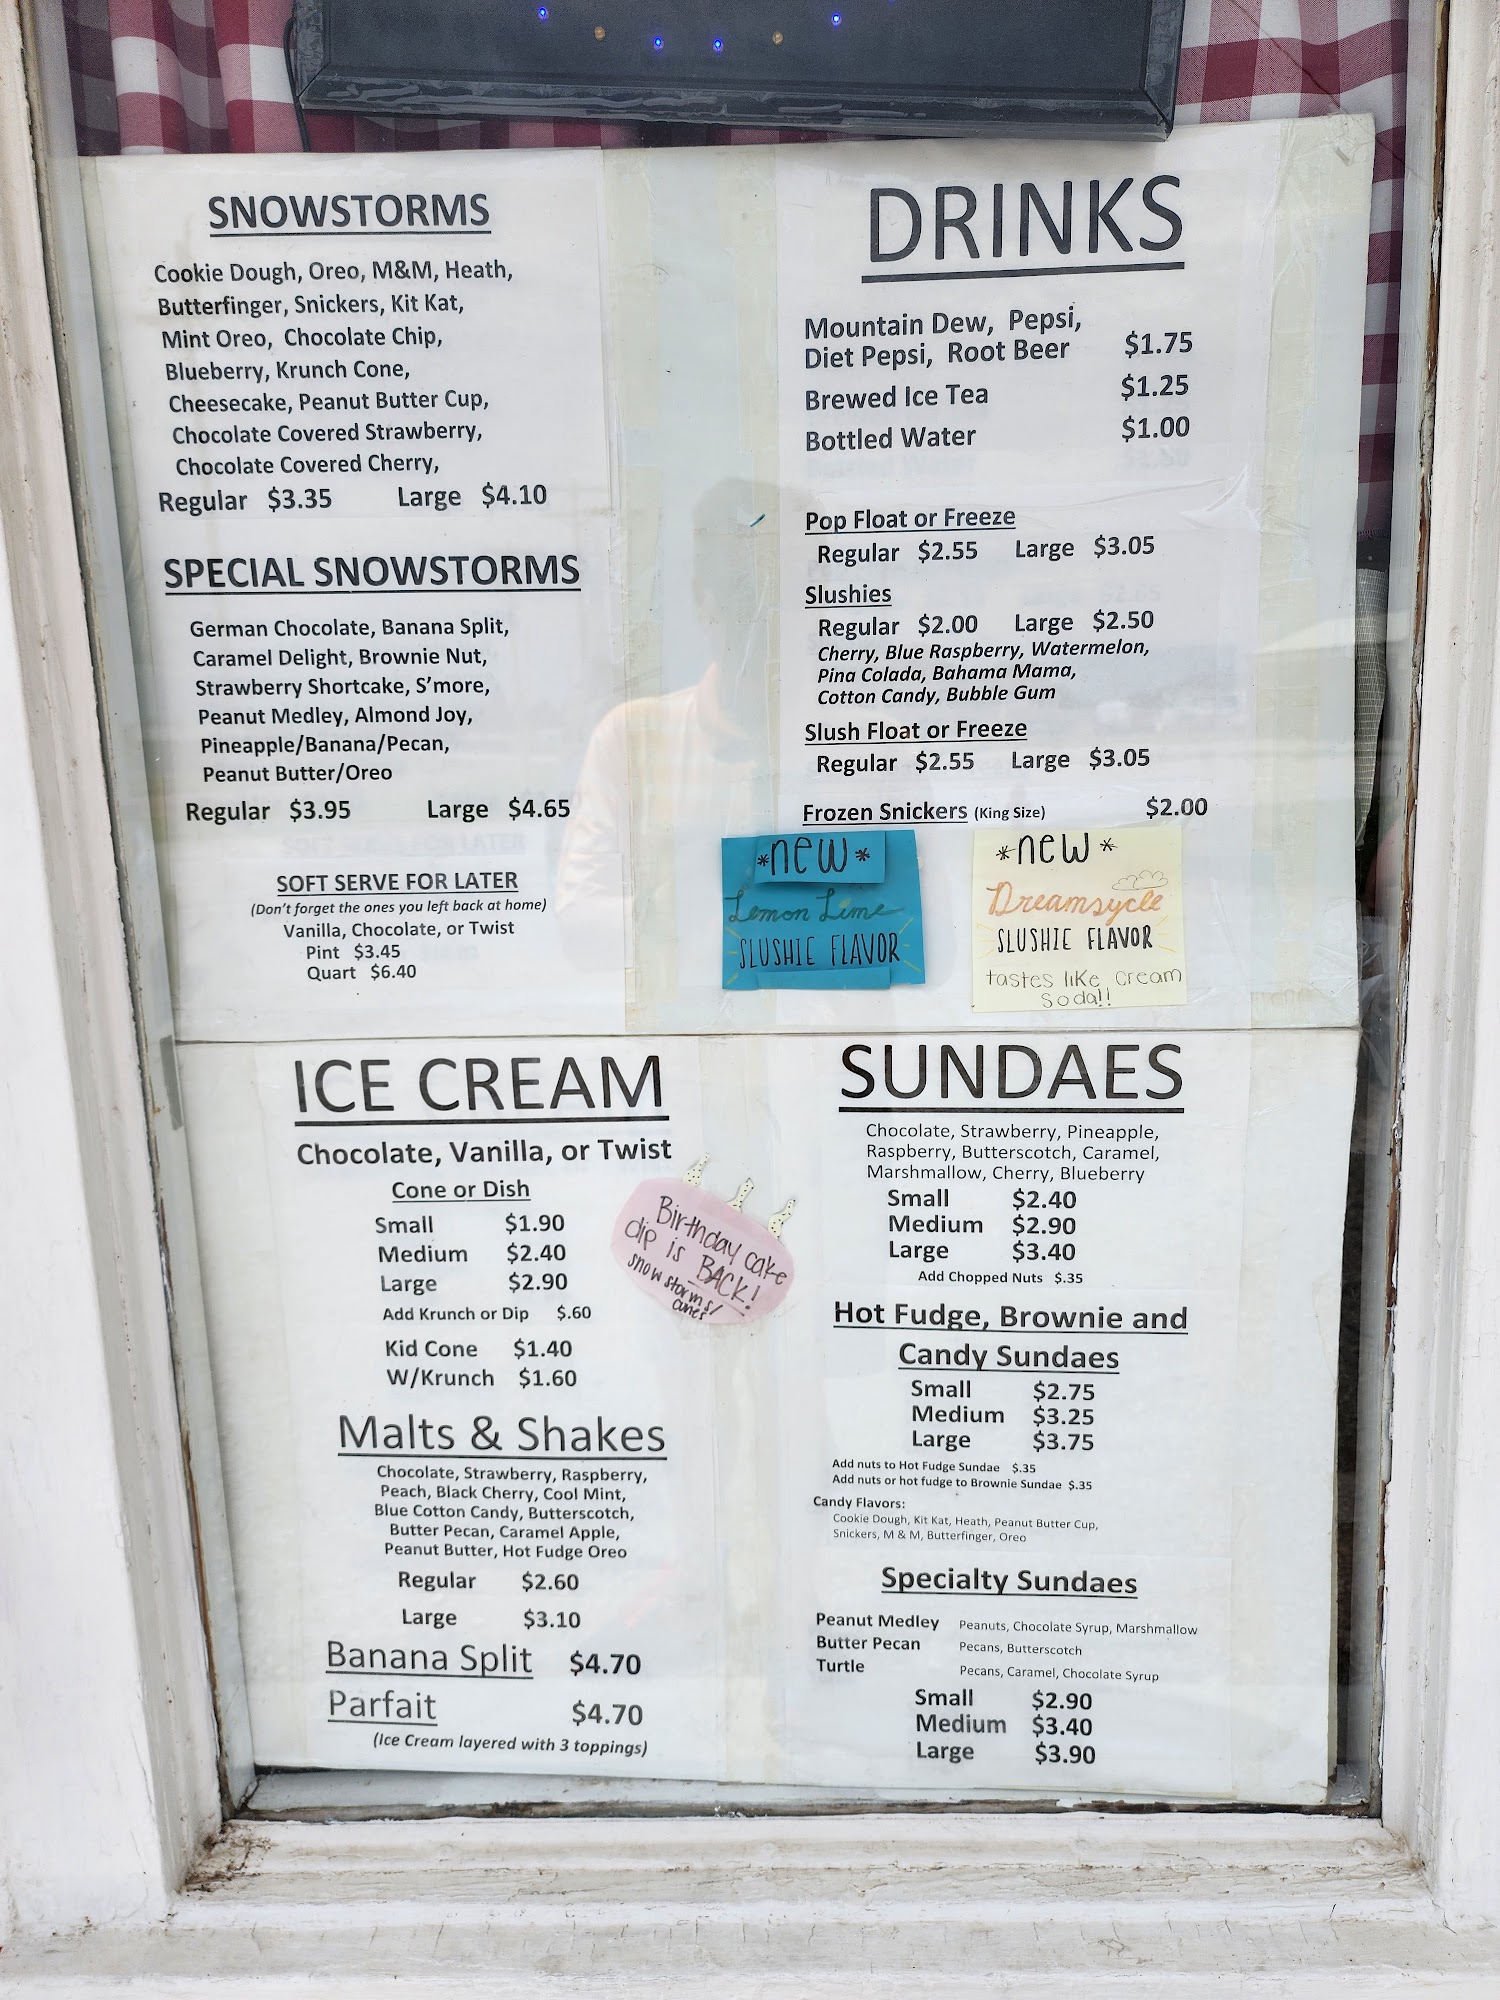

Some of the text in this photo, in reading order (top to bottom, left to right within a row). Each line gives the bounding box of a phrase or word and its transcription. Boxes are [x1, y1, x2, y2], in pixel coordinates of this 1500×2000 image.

[209, 193, 491, 230] SNOWSTORMS
[869, 174, 1183, 263] DRINKS
[154, 258, 513, 287] Cookie Dough, Oreo, M&M, Heath,
[157, 293, 464, 319] Butterfinger, Snickers, Kit Kat,
[805, 331, 1193, 371] Diet Pepsi, Root Beer $1.75
[806, 415, 1190, 452] Bottled Water $1.00
[158, 483, 547, 517] Regular $3.35 Large $4.10
[806, 508, 1016, 534] Pop Float or Freeze
[164, 554, 580, 589] SPECIAL SNOWSTORMS
[805, 585, 892, 604] Slushies
[190, 616, 509, 639] German Chocolate, Banana Split,
[818, 638, 1150, 664] Cherry, Blue Raspberry, Watermelon,
[200, 733, 450, 758] Pineapple/Banana/Pecan,
[803, 797, 1208, 824] Frozen Snickers (King Size) $2.00
[276, 871, 519, 893] SOFT SERVE FOR LATER
[293, 902, 336, 917] forget
[338, 901, 361, 914] the
[364, 903, 395, 914] ones
[398, 903, 424, 916] you
[427, 899, 450, 914] left
[452, 899, 484, 912] back
[487, 900, 502, 911] at
[505, 898, 547, 913] home)
[725, 888, 904, 922] Lemon Lime
[986, 881, 1164, 926] Dreamsycle
[739, 932, 901, 969] SLUSHIE FLAVOR
[997, 924, 1154, 953] SLUSHIE FLAVOR
[307, 964, 417, 982] Quart $6.40
[986, 970, 1054, 988] tastes
[295, 1055, 663, 1113] ICE CREAM
[841, 1044, 1183, 1100] SUNDAES
[297, 1138, 672, 1168] Chocolate, Vanilla, or Twist
[866, 1143, 1160, 1162] Raspberry, Butterscotch, Caramel,
[375, 1213, 565, 1236] Small $1.90
[888, 1214, 1076, 1237] Medium $2.90
[656, 1195, 788, 1285] Birthday cake
[625, 1217, 761, 1310] dip is BACK!
[918, 1270, 1084, 1286] Add Chopped Nuts $.35
[382, 1305, 592, 1323] Add Krunch or Dip $.60
[834, 1300, 1188, 1331] Hot Fudge, Brownie and
[386, 1366, 577, 1389] W/Krunch $1.60
[339, 1413, 666, 1453] Malts & Shakes
[832, 1458, 1036, 1474] Add nuts to Hot Fudge Sundae $.35
[813, 1496, 905, 1510] Candy Flavors:
[833, 1529, 1027, 1543] Snickers, M & M, Butterfinger, Oreo
[881, 1566, 1138, 1595] Specialty Sundaes
[816, 1613, 940, 1631] Peanut Medley
[959, 1619, 1198, 1635] Peanuts, Chocolate Syrup, Marshmallow
[327, 1640, 642, 1679] Banana Split $4.70
[816, 1657, 865, 1674] Turtle
[960, 1665, 1159, 1683] Pecans, Caramel, Chocolate Syrup
[373, 1732, 648, 1758] (Ice Cream layered with 3 toppings)
[916, 1741, 1096, 1765] Large $3.90
